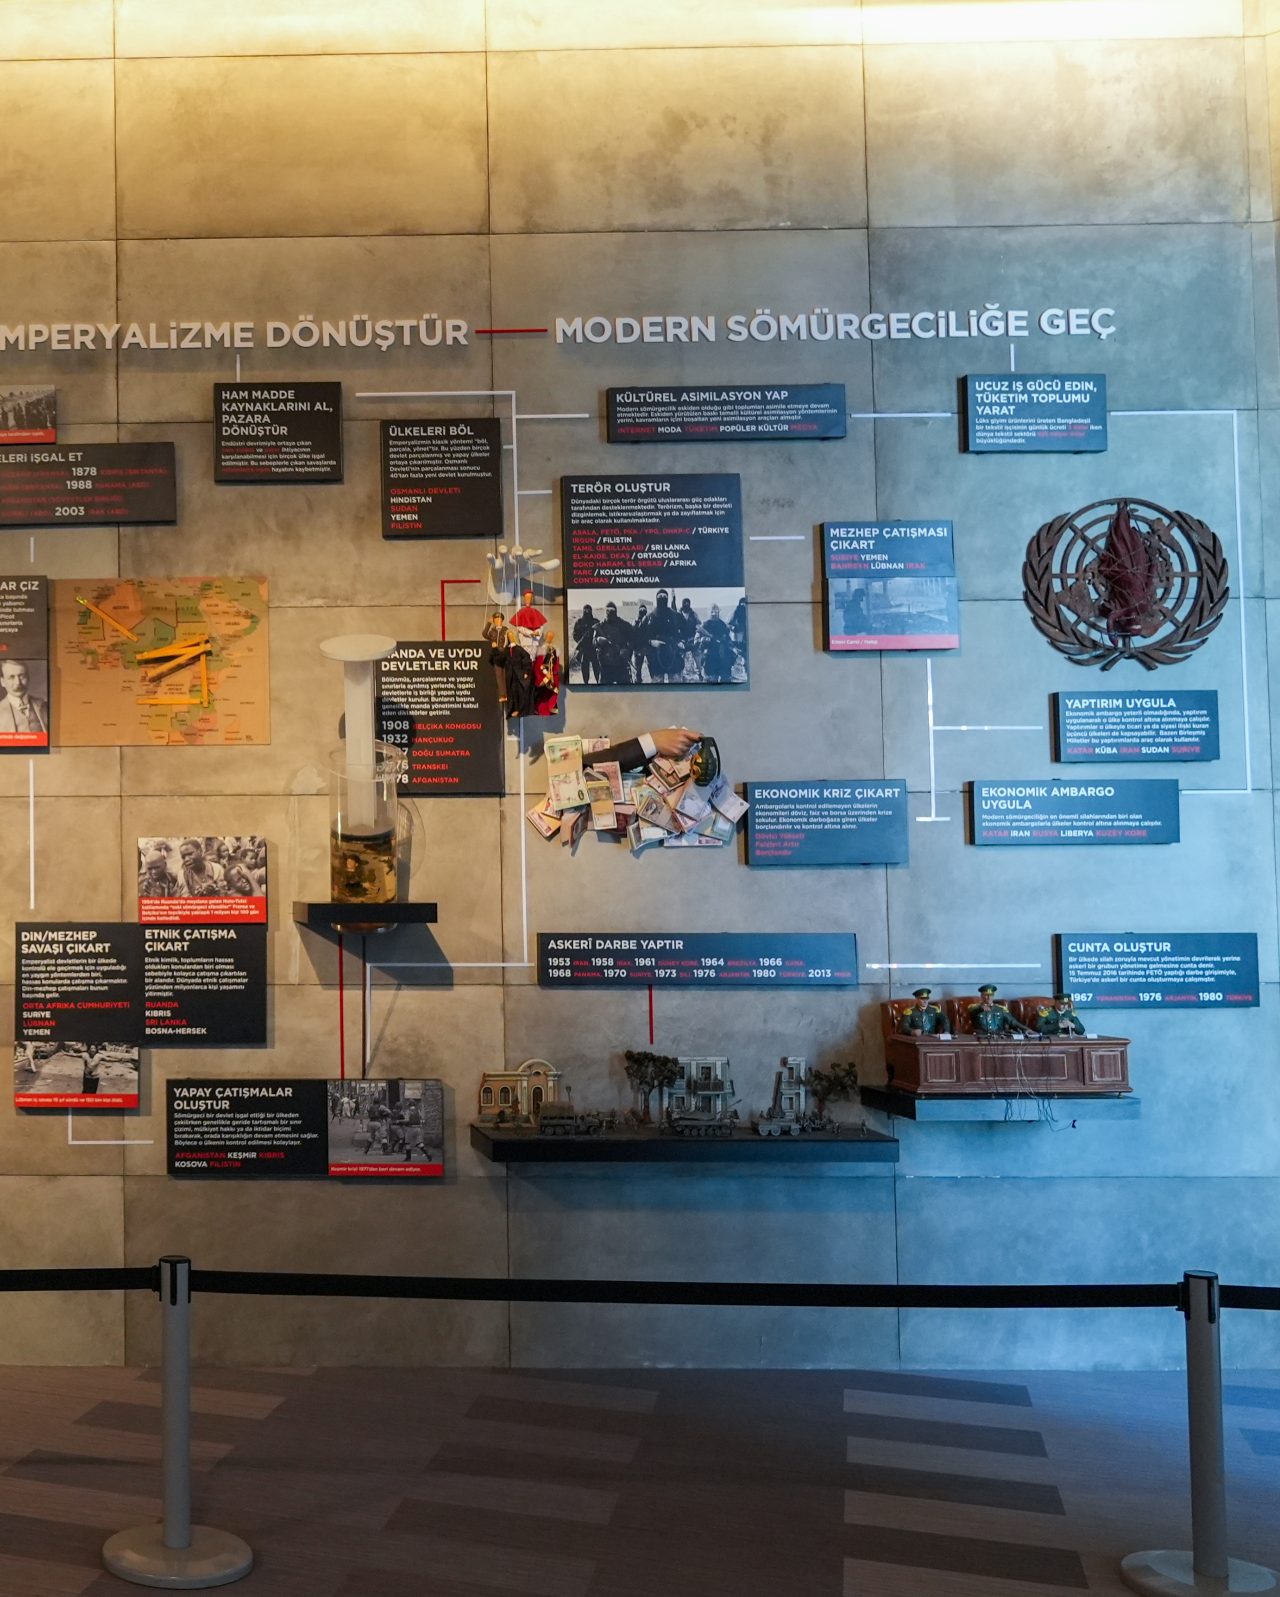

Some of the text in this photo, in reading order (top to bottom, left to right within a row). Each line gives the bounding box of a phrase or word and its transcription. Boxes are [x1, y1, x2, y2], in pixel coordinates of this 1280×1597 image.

[555, 316, 716, 344] MODERN
[1038, 307, 1117, 341] GEÇ
[266, 313, 468, 351] DÖNÜŞTÜR
[976, 381, 1009, 391] UCUZ
[1027, 379, 1061, 391] GÜCÜ
[222, 390, 295, 399] HAM MADDE
[616, 391, 677, 402] KÜLTÜREL
[765, 390, 789, 401] YAP
[1032, 393, 1090, 403] TOPLUMU
[222, 402, 333, 412] KAYNAKLARINI AL,
[976, 405, 1015, 415] YARAT
[222, 414, 271, 424] PAZARA
[222, 425, 288, 437] DÖNÜŞTÜR
[450, 424, 474, 436] BÖL
[719, 424, 789, 432] POPÜLER KÜLTÜR
[69, 452, 83, 462] ET
[72, 467, 97, 476] 1878
[571, 482, 670, 494] TERÖR OLUŞTUR
[55, 507, 85, 516] 2003
[830, 528, 947, 538] MEZHEP ÇATIŞMASI
[830, 540, 875, 551] ÇIKART
[637, 551, 679, 559] ORTADOĞU
[871, 561, 904, 569] LÜBNAN
[386, 649, 482, 659] ANDA VE UYDU
[381, 661, 478, 671] DEVLETLER KUR
[1065, 698, 1176, 709] YAPTIRIM UYGULA
[382, 720, 410, 731] 1908
[382, 734, 408, 744] 1932
[855, 788, 901, 799] ÇIKART
[1051, 787, 1114, 797] AMBARGO
[982, 800, 1032, 810] UYGULA
[184, 929, 236, 940] ÇATIŞMA
[21, 943, 110, 955] SAVAŞI ÇIKART
[145, 941, 189, 953] ÇIKART
[595, 939, 638, 950] DARBE
[641, 939, 684, 950] YAPTIR
[1068, 942, 1171, 954] CUNTA OLUŞTUR
[548, 957, 571, 966] 1953
[701, 957, 724, 966] 1964
[808, 969, 832, 978] 2013
[1070, 993, 1093, 1001] 1967
[1139, 993, 1162, 1001] 1976
[1199, 993, 1222, 1001] 1980
[145, 1027, 207, 1035] BOSNA-HERSEK
[174, 1087, 292, 1099] YAPAY ÇATIŞMALAR
[174, 1100, 230, 1112] OLUŞTUR
